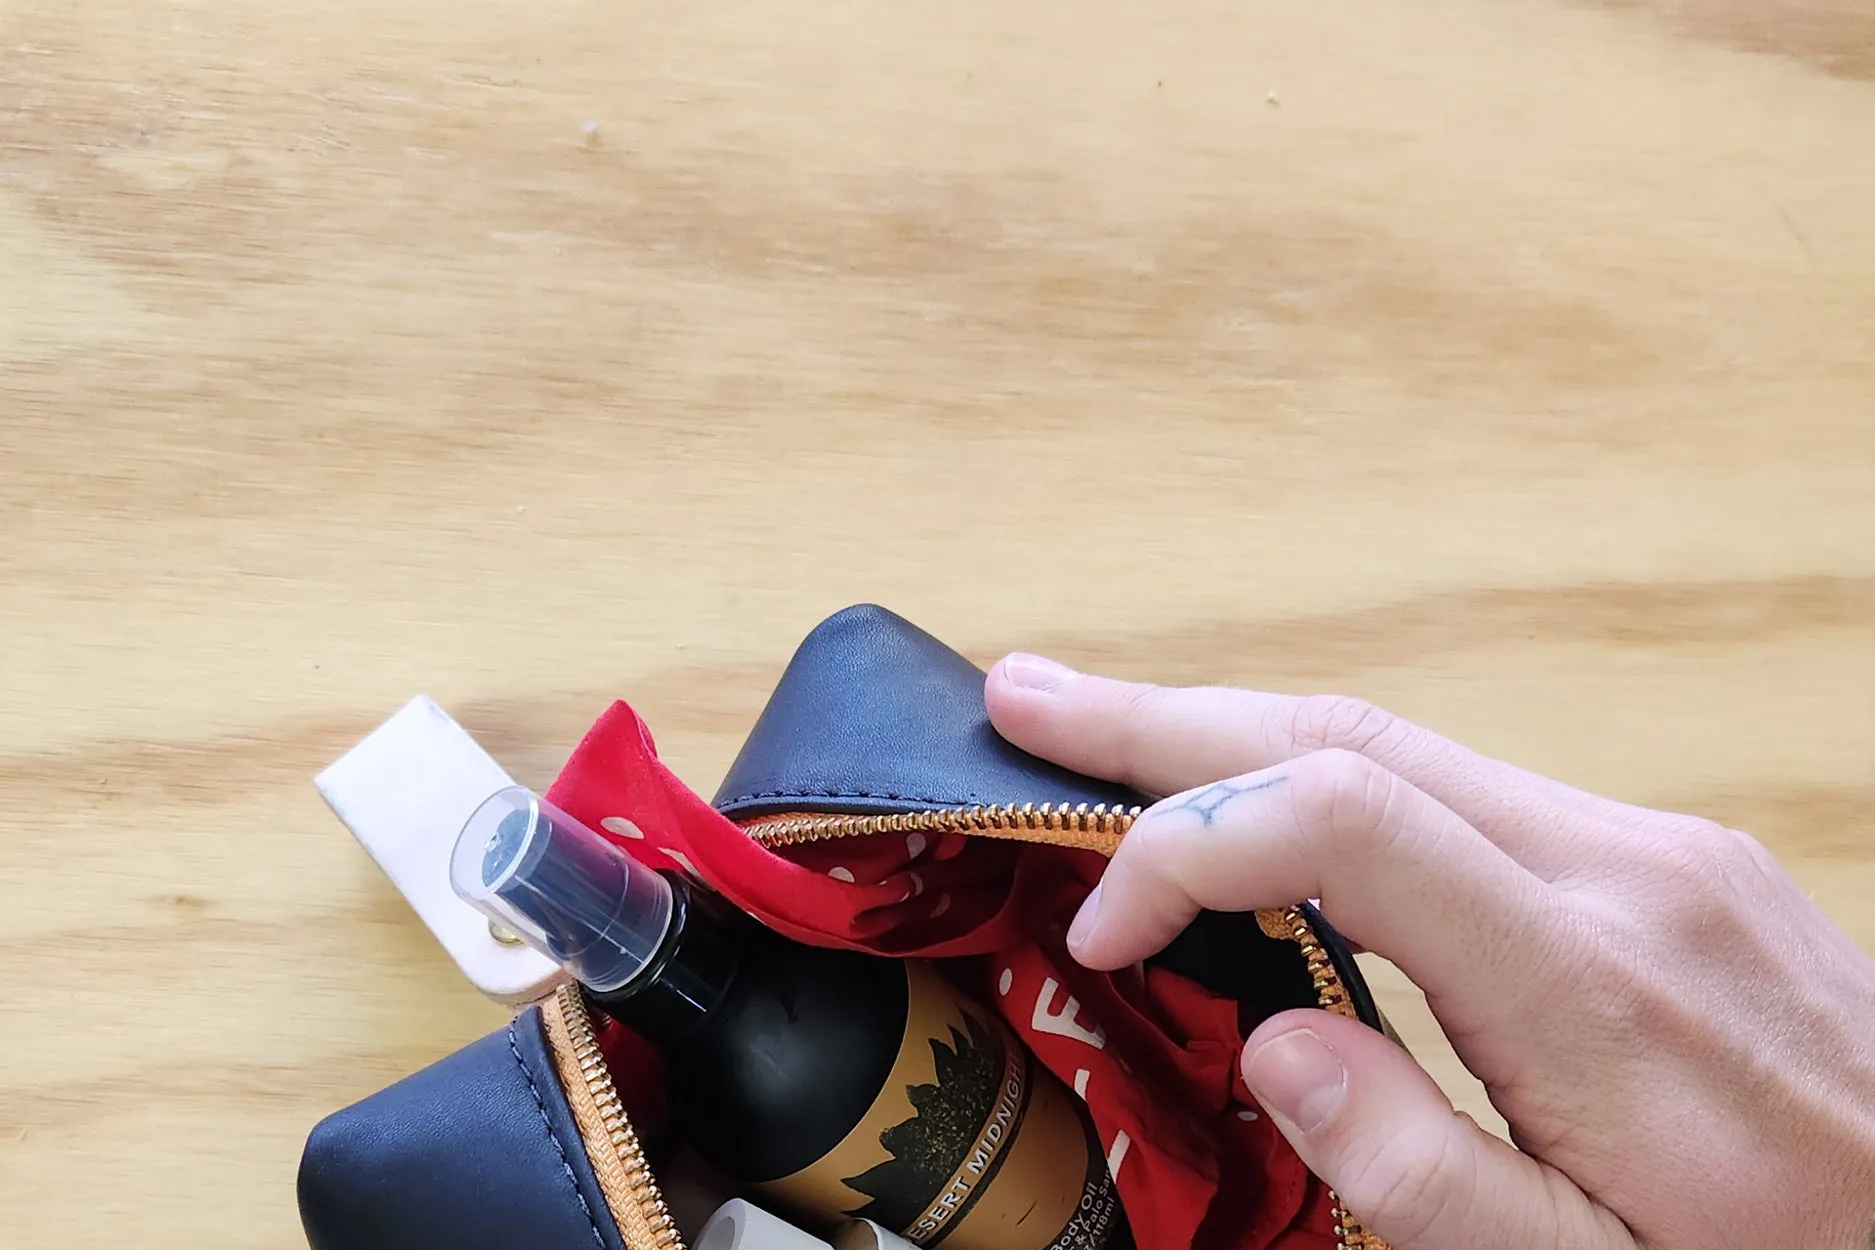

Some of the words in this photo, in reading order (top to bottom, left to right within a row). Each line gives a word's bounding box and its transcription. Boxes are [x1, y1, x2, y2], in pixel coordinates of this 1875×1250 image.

[908, 1176, 971, 1241] ESERT
[1081, 1182, 1098, 1211] Oil
[1075, 1234, 1087, 1245] &
[1083, 1200, 1104, 1232] Palo
